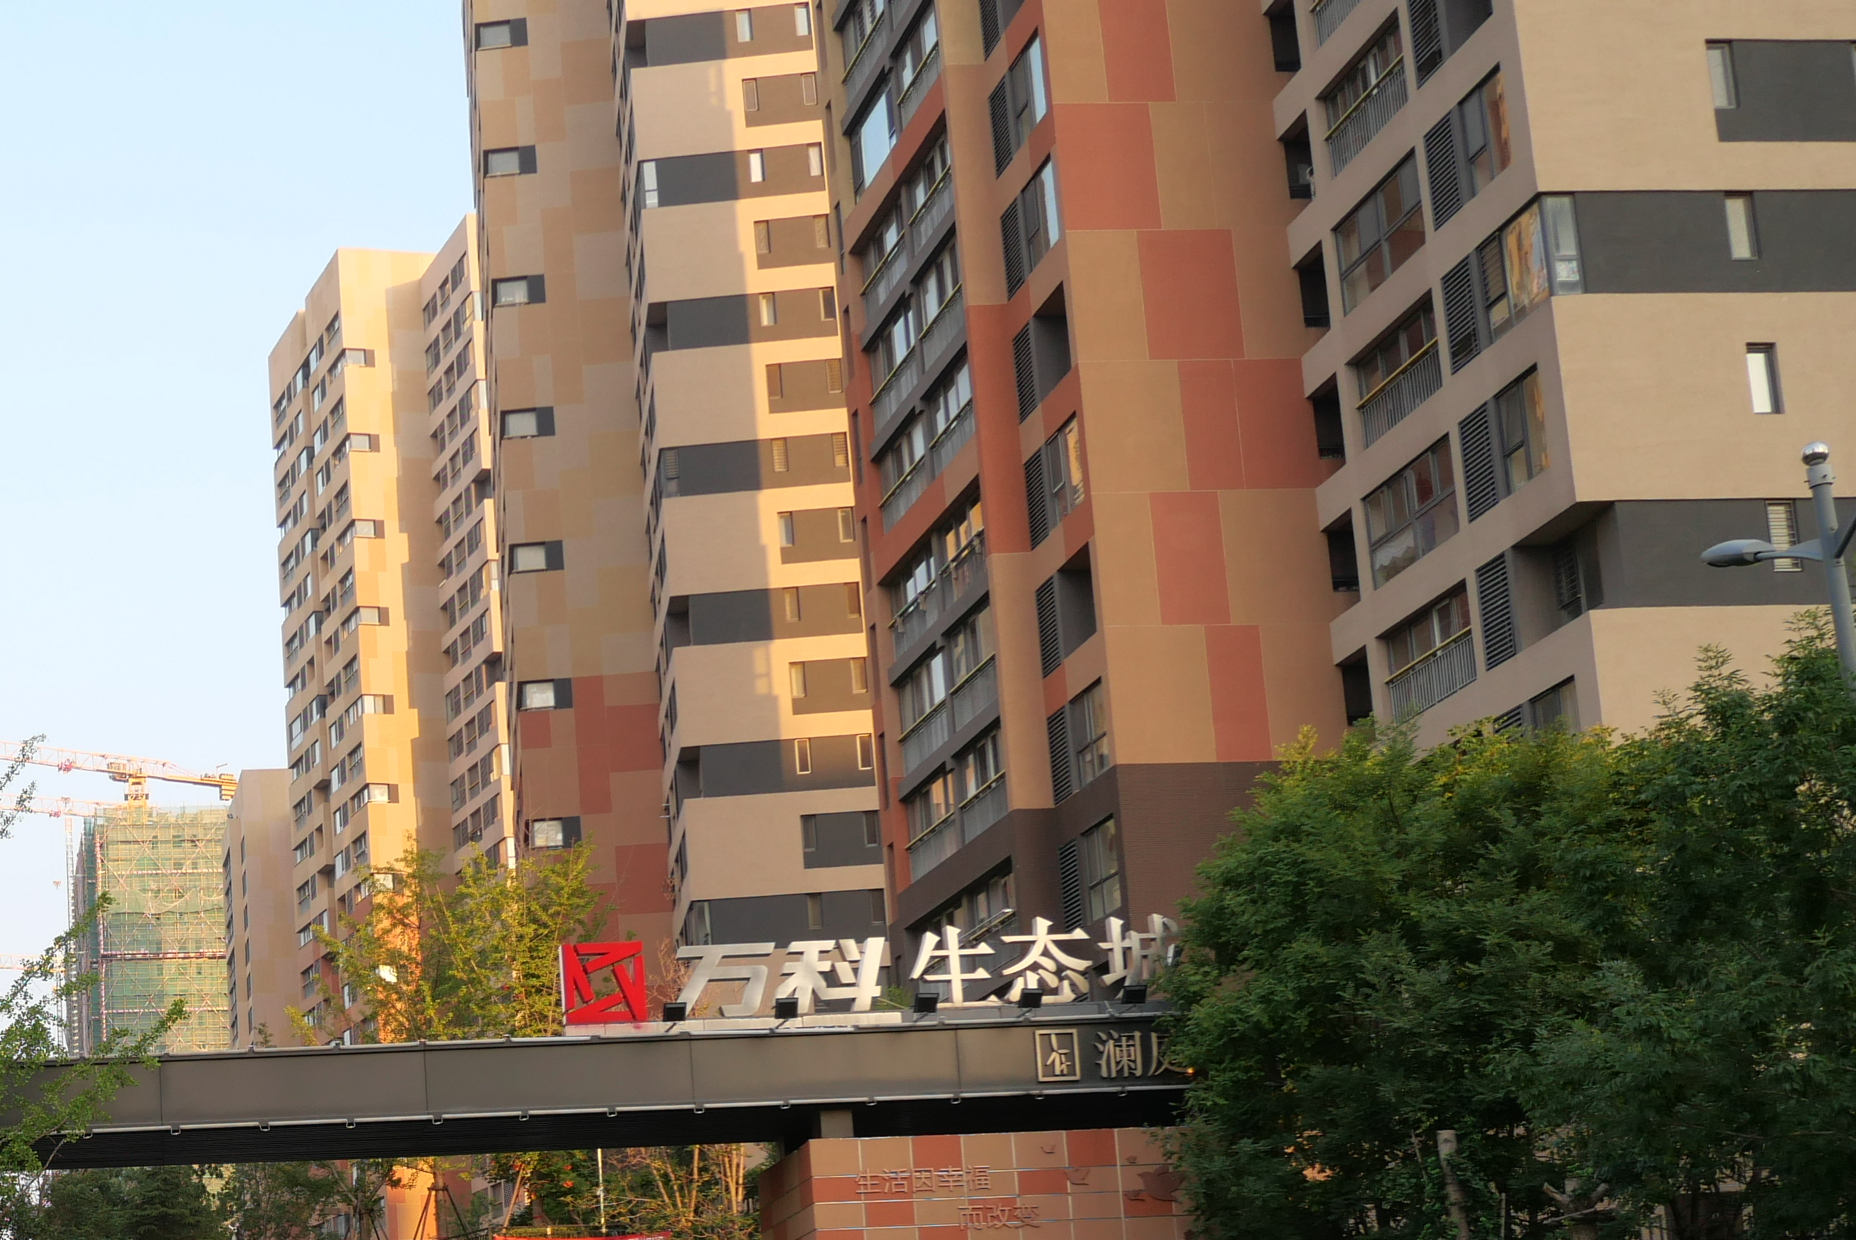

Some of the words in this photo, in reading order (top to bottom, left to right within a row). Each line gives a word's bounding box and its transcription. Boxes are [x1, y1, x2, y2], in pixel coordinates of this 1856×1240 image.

[855, 1165, 992, 1195] 生活因幸福
[957, 1203, 1041, 1231] 而改变
